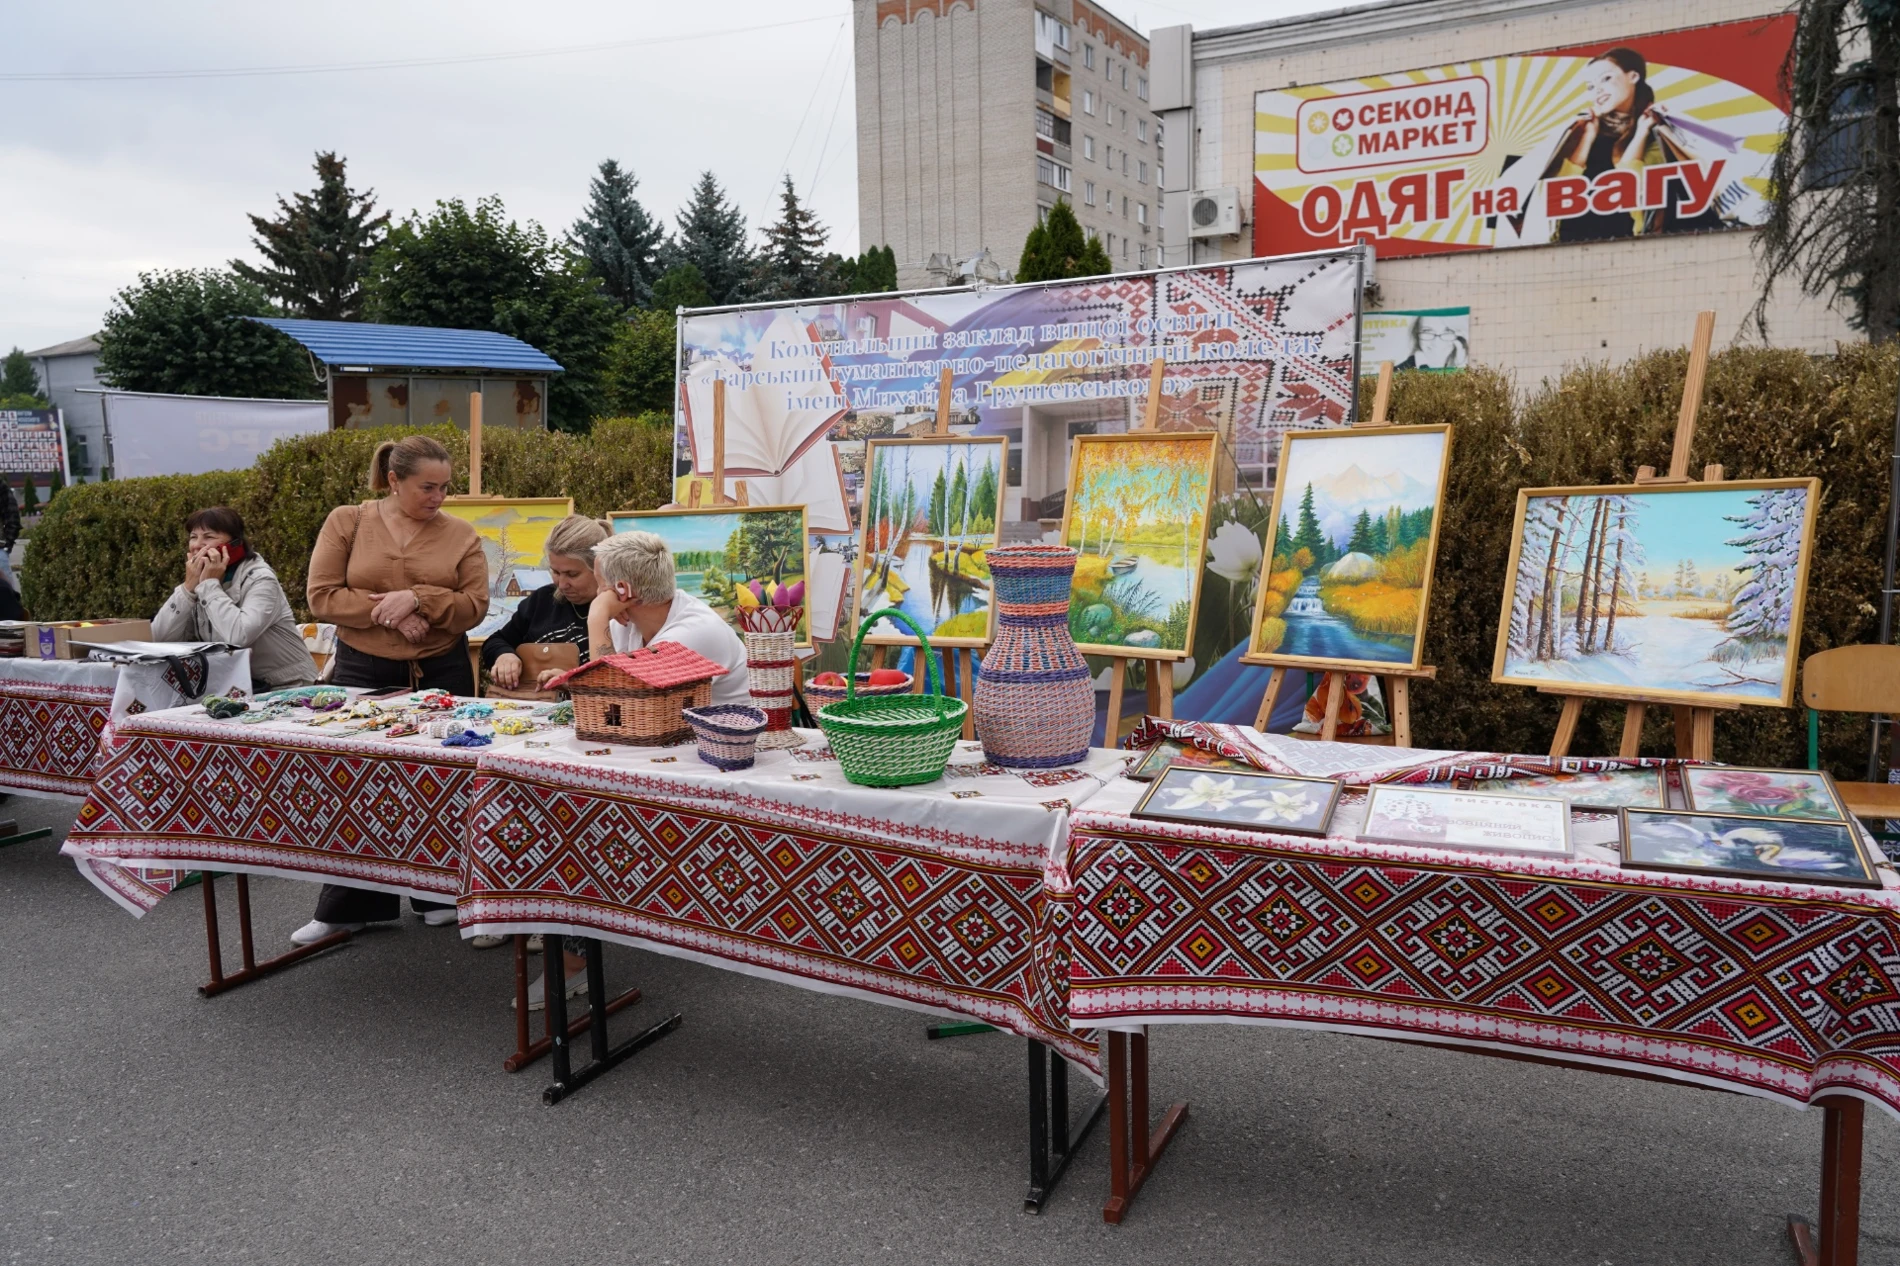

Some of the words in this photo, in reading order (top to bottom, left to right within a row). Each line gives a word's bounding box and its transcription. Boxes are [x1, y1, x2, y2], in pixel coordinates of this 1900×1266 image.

[1358, 90, 1477, 128] СЕКОНД
[1357, 119, 1477, 156] МАРКЕТ
[1301, 168, 1465, 239] ОДЯГ
[1471, 186, 1519, 217] на
[770, 327, 938, 360] Комунальний
[943, 324, 1035, 349] заклад
[1040, 313, 1131, 342] вищої
[1137, 305, 1234, 334] освіти
[829, 336, 1191, 383] гуманітарно-педагогічний
[1199, 334, 1322, 361] коледж
[787, 382, 849, 411] імені
[853, 383, 969, 409] Михайа
[1454, 797, 1553, 809] ВИСТАВКА
